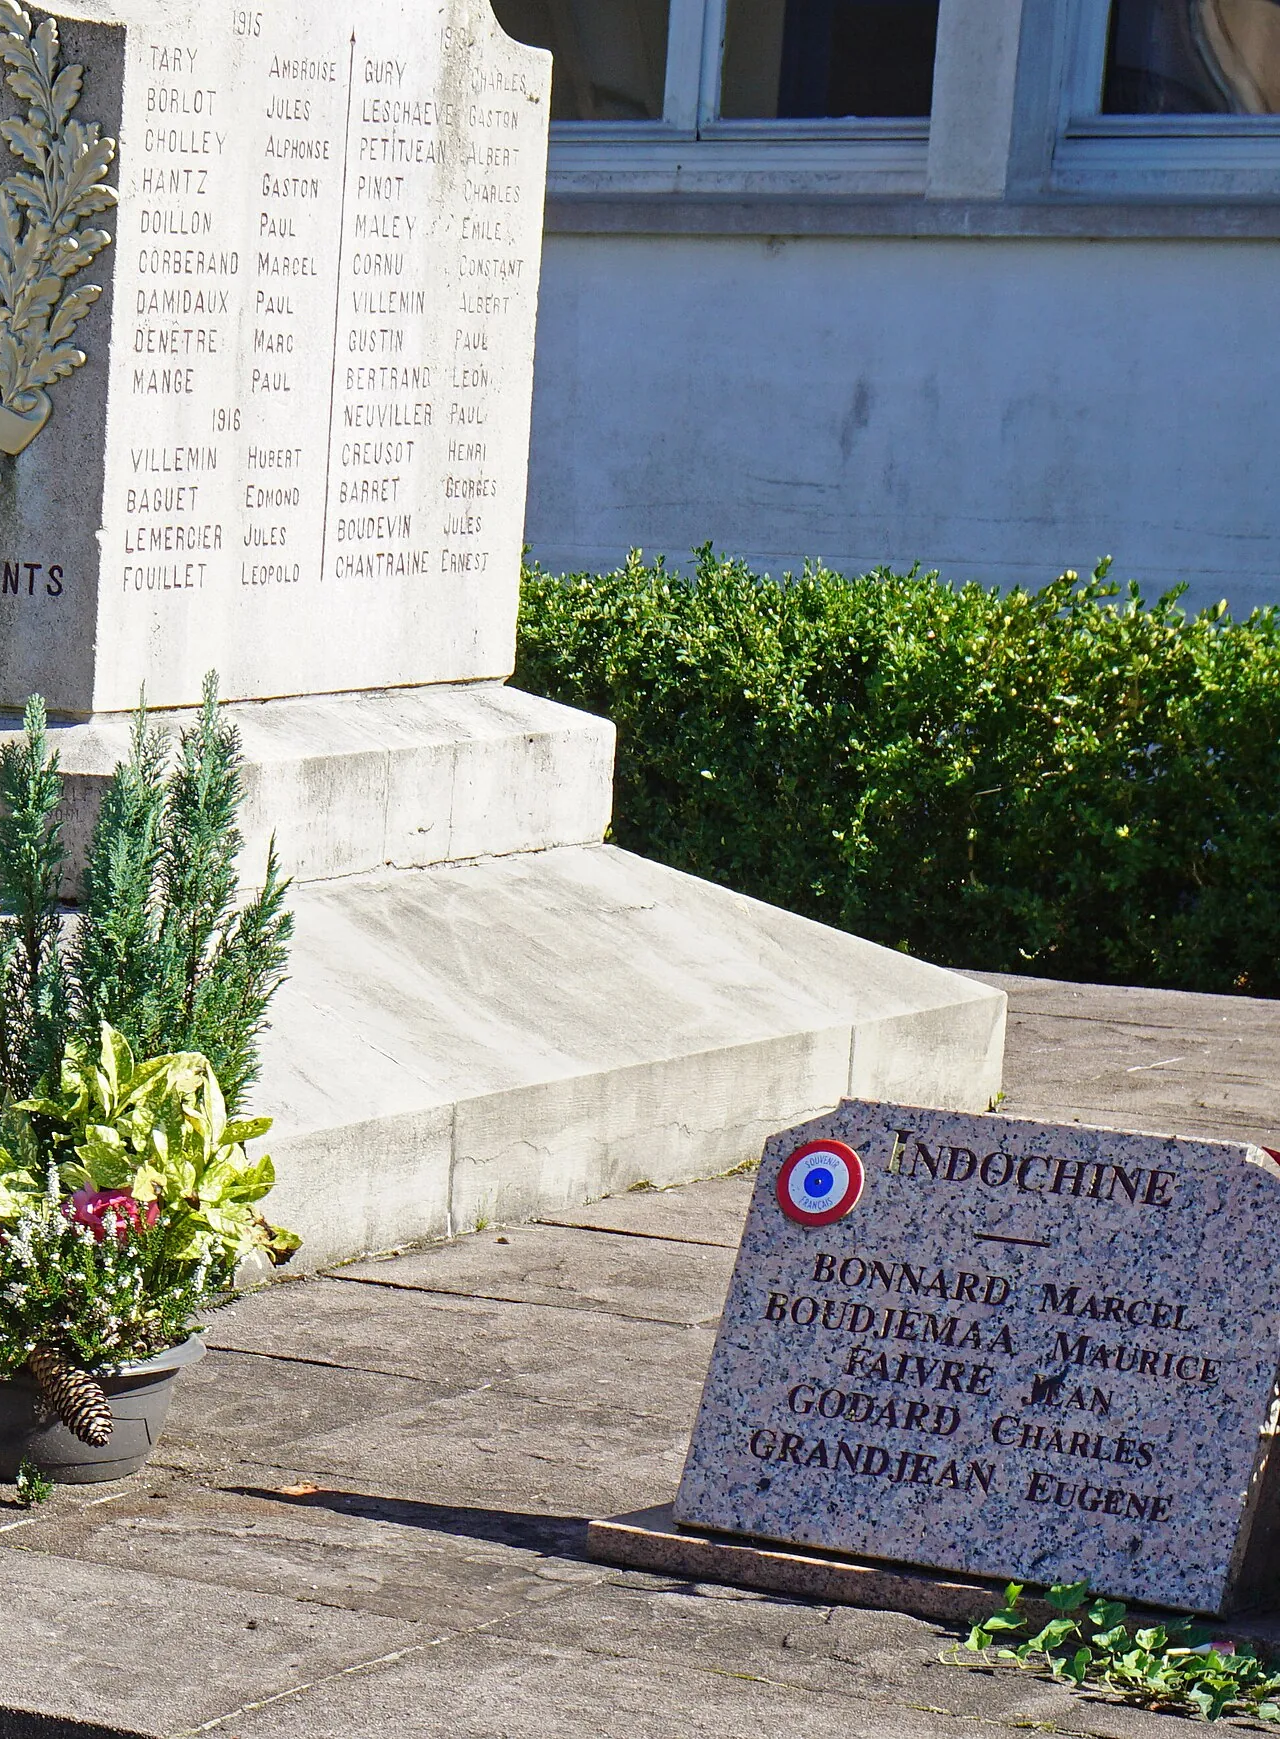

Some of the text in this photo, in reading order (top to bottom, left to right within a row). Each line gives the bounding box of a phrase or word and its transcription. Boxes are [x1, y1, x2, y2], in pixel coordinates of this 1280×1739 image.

[233, 12, 262, 36] 1915
[150, 46, 336, 82] TARY AMBROISE
[364, 60, 526, 94] GURY CHARLES
[147, 88, 311, 120] BORLOT JULES
[469, 105, 519, 127] GASTON
[145, 130, 330, 160] CHOLLEY ALPHONSE
[360, 136, 520, 164] PETITJEAN ALBERT
[143, 170, 318, 199] HANTZ GASTON
[358, 176, 521, 203] PINOT CHARLES
[140, 211, 296, 238] DOILLON PAUL
[356, 214, 416, 240] MALEY
[138, 250, 317, 277] CORBERAND MARCEL
[353, 253, 524, 278] CORNU CONSTANT
[136, 289, 294, 315] DAMIDAUX PAUL
[353, 291, 509, 316] VILLEMIN ALBERT
[254, 328, 294, 353] MARC
[348, 329, 489, 354] GUSTIN PAUL
[133, 368, 290, 394] MANGE PAUL
[346, 366, 431, 391] BERTRAND
[212, 408, 241, 432] 1916
[344, 403, 480, 428] NEUVILLER PAUL
[131, 446, 302, 473] VILLEMIN HUBERT
[341, 439, 486, 466] CREUSOT HENRI
[127, 485, 300, 514] BAGUET EDMOND
[339, 476, 497, 503] BARRET GEORGES
[125, 524, 286, 554] LEMERCIER JULES
[338, 513, 482, 542] BOUDEVIN JULES
[123, 563, 300, 591] FOUILLET LEOPOLD
[336, 549, 488, 580] CHANTRAINE ERNEST
[804, 1154, 840, 1169] SOUVENIR
[888, 1128, 1175, 1208] INDOCHINE
[812, 1253, 1193, 1332] BONNARD MARCEL
[764, 1291, 1222, 1386] BOUDJEMAA MAURICE
[845, 1346, 1115, 1416] FAIVRE JEAN
[788, 1384, 1156, 1468] GODARD CHARLES
[750, 1429, 1173, 1524] GRANDJEAN EUGENE
